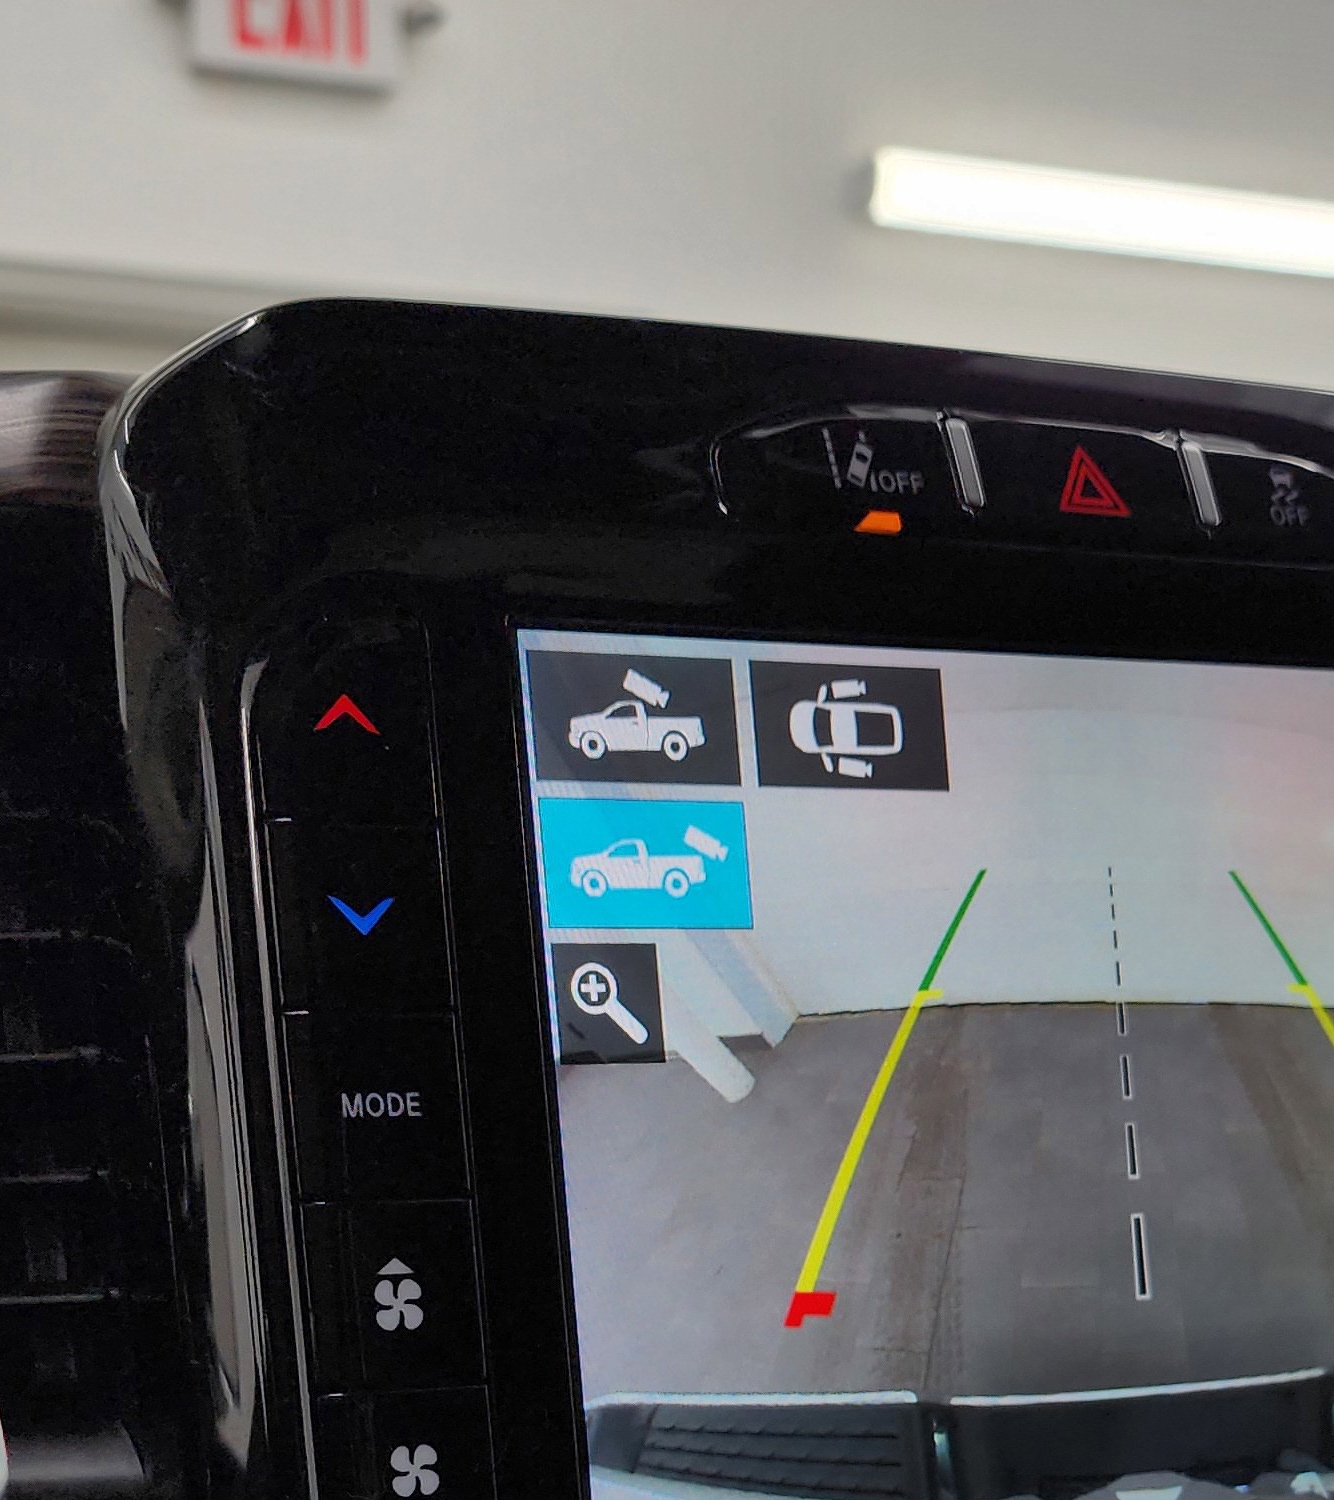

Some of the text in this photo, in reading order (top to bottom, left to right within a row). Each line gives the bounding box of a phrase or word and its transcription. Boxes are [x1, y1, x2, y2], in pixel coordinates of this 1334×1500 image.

[878, 469, 924, 495] OFF
[1270, 504, 1309, 527] OFF
[341, 1090, 423, 1120] MODE
